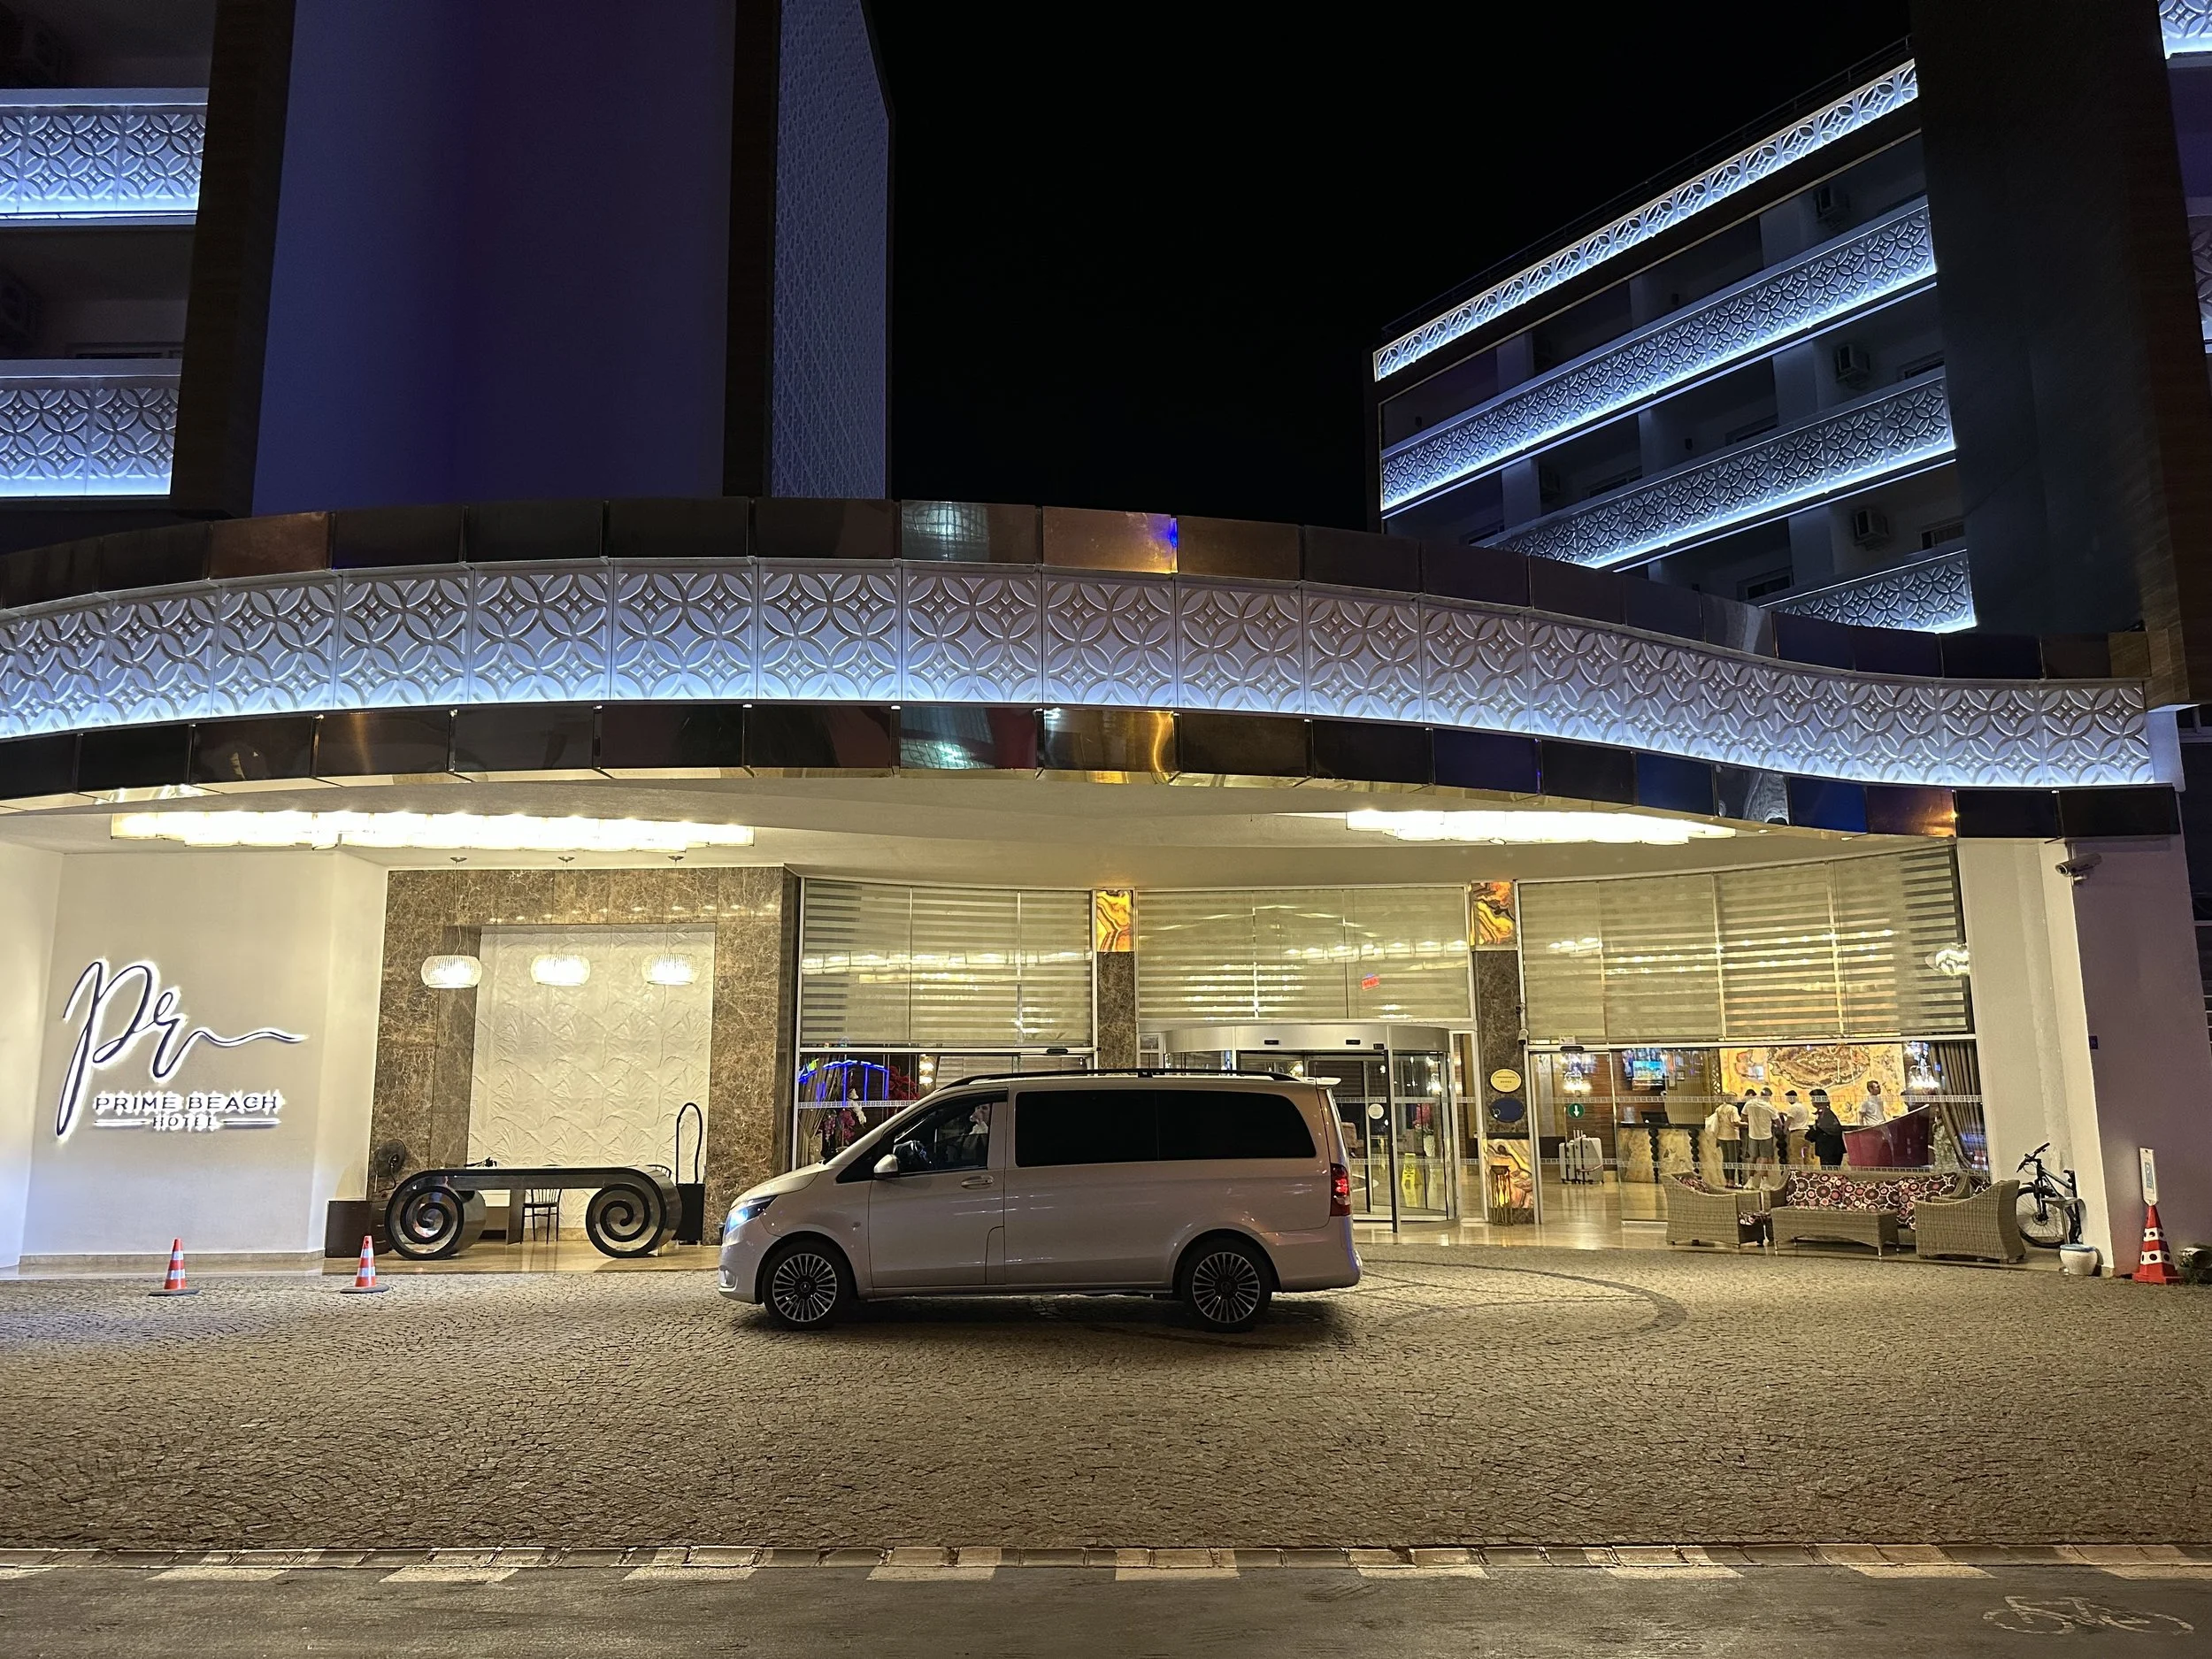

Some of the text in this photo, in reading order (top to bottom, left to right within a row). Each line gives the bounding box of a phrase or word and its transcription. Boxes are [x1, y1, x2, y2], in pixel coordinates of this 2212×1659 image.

[95, 1095, 277, 1110] PRIME BEACH
[152, 1116, 215, 1128] HOTEL
